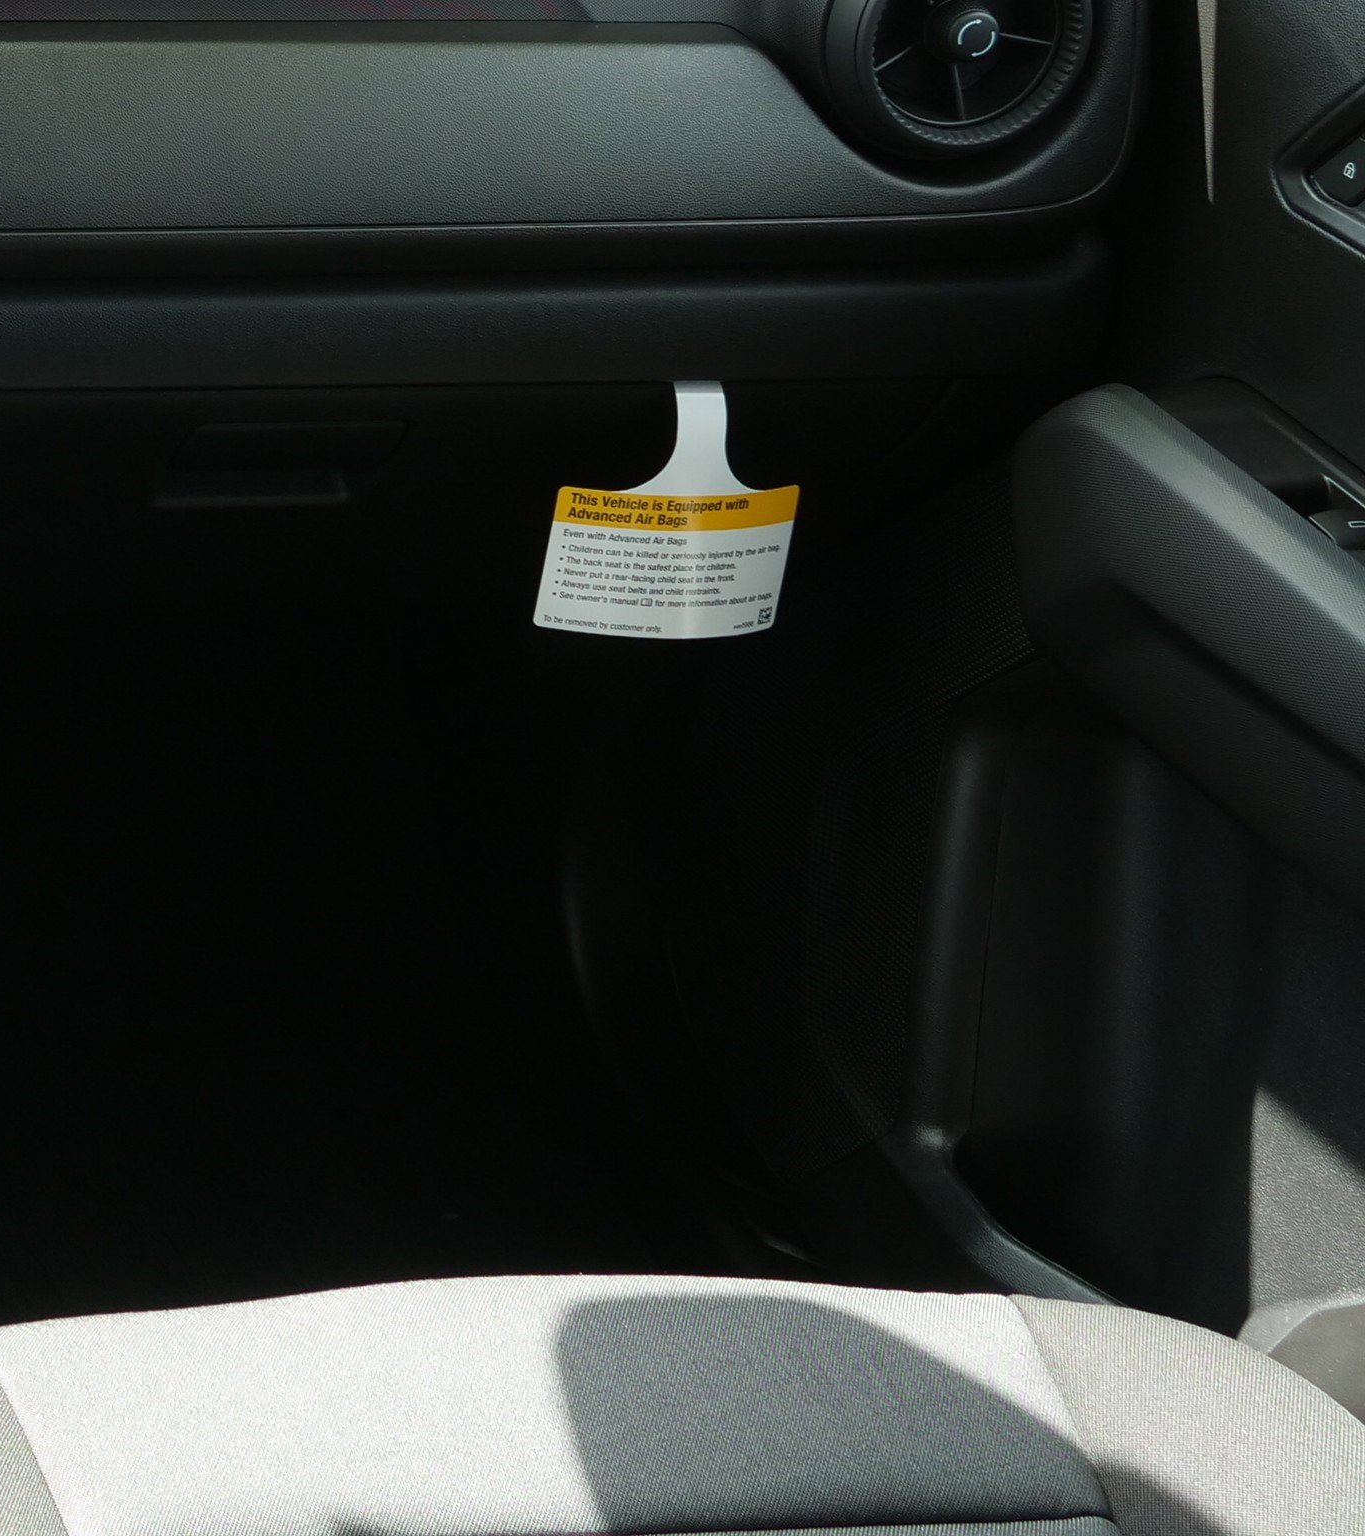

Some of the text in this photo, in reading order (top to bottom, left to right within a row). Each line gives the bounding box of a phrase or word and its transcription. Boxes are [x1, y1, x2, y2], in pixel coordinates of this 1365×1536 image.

[571, 492, 750, 514] This Vehicle is Equipped with
[567, 507, 689, 528] Advanced Air Bags
[563, 528, 688, 547] Even with Advanced Air Bags
[568, 544, 604, 555] Children
[622, 549, 634, 558] be
[635, 550, 659, 559] killed
[566, 556, 582, 565] The
[582, 558, 603, 567] back
[604, 561, 622, 569] seat
[632, 562, 646, 571] the
[647, 563, 672, 572] safest
[672, 564, 695, 573] place
[695, 563, 706, 572] for
[563, 568, 716, 584] Never put rear-facing child seat in the
[543, 614, 662, 633] To be removed by customer only.
